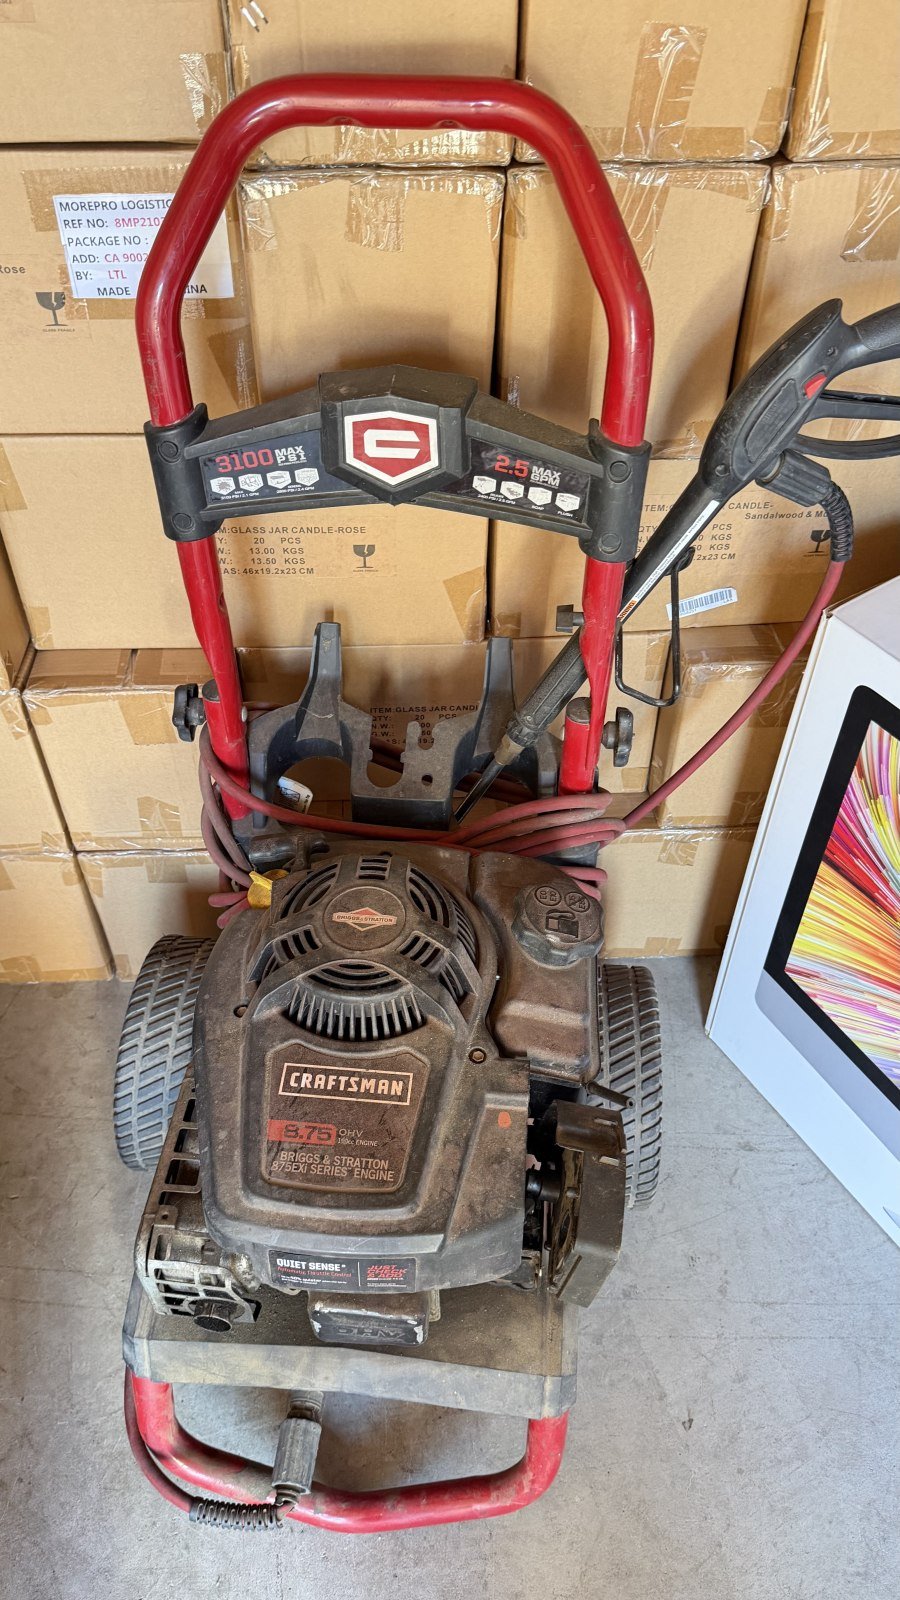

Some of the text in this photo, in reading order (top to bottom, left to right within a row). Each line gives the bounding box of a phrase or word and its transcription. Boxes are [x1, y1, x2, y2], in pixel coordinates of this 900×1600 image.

[59, 201, 118, 212] MOREPRO
[63, 218, 109, 229] REF NO:
[67, 236, 120, 247] PACKAGE
[123, 235, 141, 246] NO
[72, 254, 100, 264] ADD:
[104, 253, 121, 263] CA
[75, 270, 128, 281] BY: LTL
[97, 287, 132, 297] MADE
[214, 445, 305, 473] 3100 MAX
[494, 454, 562, 480] 2.5 MAX
[530, 473, 560, 487] GPM
[728, 501, 774, 510] CANDLE-
[744, 511, 804, 520] Sandalwood
[217, 526, 366, 534] M:GLASS JAR CANDLE-ROSE
[712, 523, 733, 531] PCS
[253, 537, 265, 545] 20
[280, 537, 301, 545] PCS
[711, 533, 732, 541] KGS
[249, 547, 275, 555] 13.00
[282, 547, 304, 555] KGS
[709, 543, 730, 551] KGS
[250, 557, 277, 565] 13.50
[284, 557, 306, 565] KGS
[242, 567, 297, 575] 46x19.2x23
[298, 567, 315, 575] CM
[369, 706, 427, 714] ITEM:GLASS
[289, 1072, 404, 1096] CRAFTSMAN
[283, 1123, 364, 1142] 8.75 OHV
[355, 1138, 379, 1147] ENGINE
[279, 1150, 389, 1170] BRIGGS & STRATTON
[271, 1160, 308, 1173] 875EXi
[353, 1168, 395, 1182] ENGINE
[276, 1258, 307, 1270] QUIET
[277, 1266, 306, 1275] Automatic
